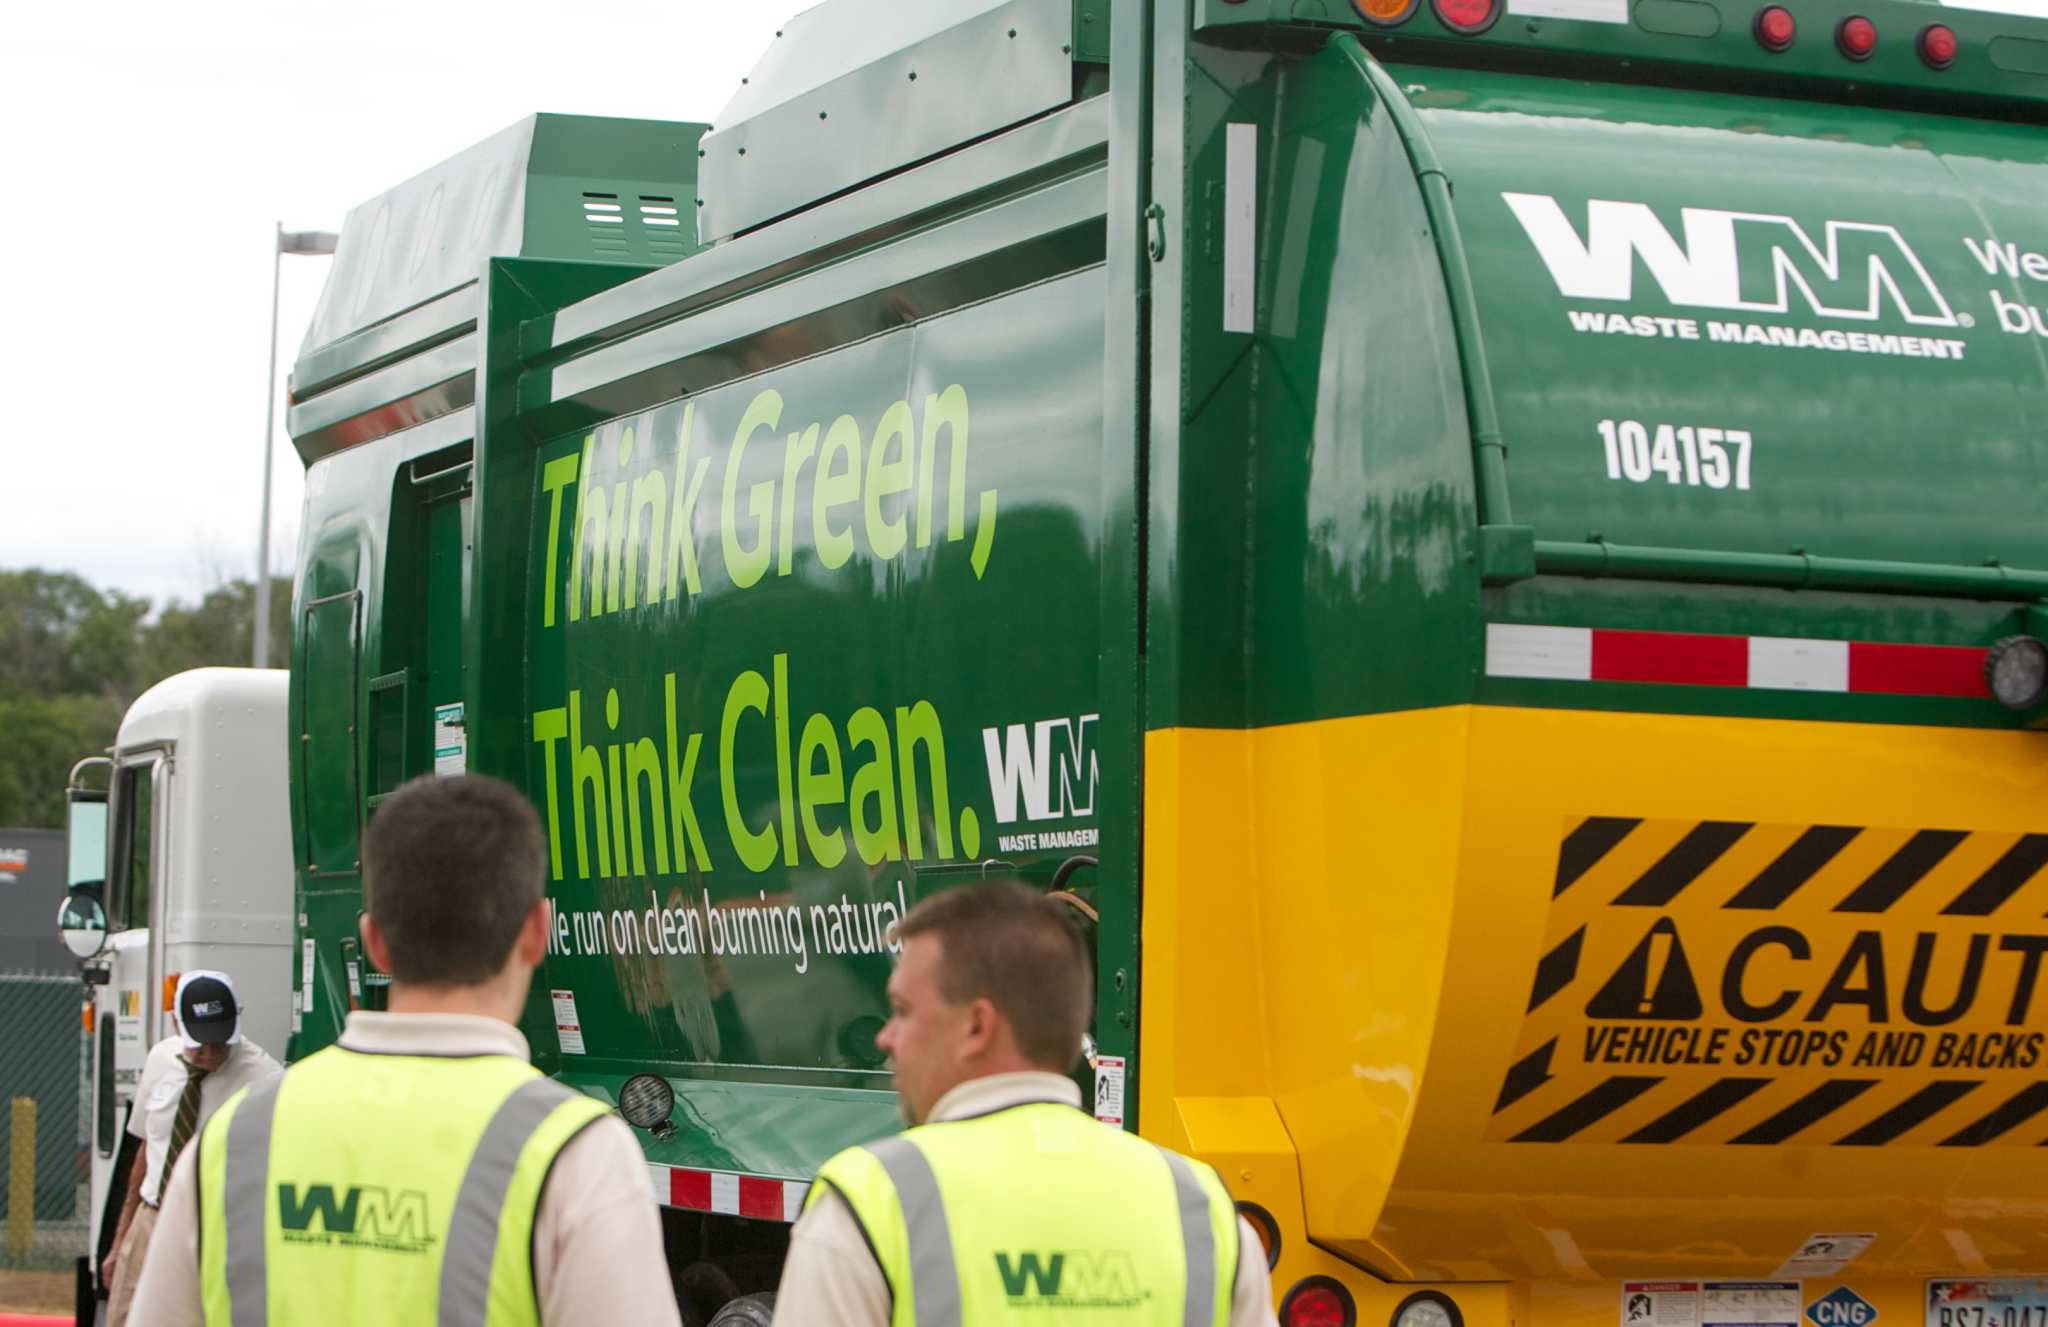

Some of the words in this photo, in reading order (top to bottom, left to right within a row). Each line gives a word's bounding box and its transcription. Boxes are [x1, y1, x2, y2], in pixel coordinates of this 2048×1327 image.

[1500, 191, 1960, 328] WM
[1567, 311, 1700, 341] WASTE
[1706, 321, 1966, 359] MANAGEMENT
[1597, 419, 1752, 490] 104157
[541, 400, 712, 628] Think
[720, 384, 998, 588] Green,
[532, 672, 713, 881] Think
[718, 653, 981, 872] Clean.
[998, 833, 1037, 852] WASTE
[573, 910, 608, 955] run
[611, 908, 641, 955] on
[643, 890, 706, 954] clean
[703, 888, 808, 974] burning
[1582, 1026, 1729, 1064] VEHICLE
[1734, 1029, 1848, 1067] STOPS
[1851, 1032, 1927, 1068] AND
[1930, 1033, 2045, 1069] BACKS
[1816, 1301, 1867, 1325] CNG
